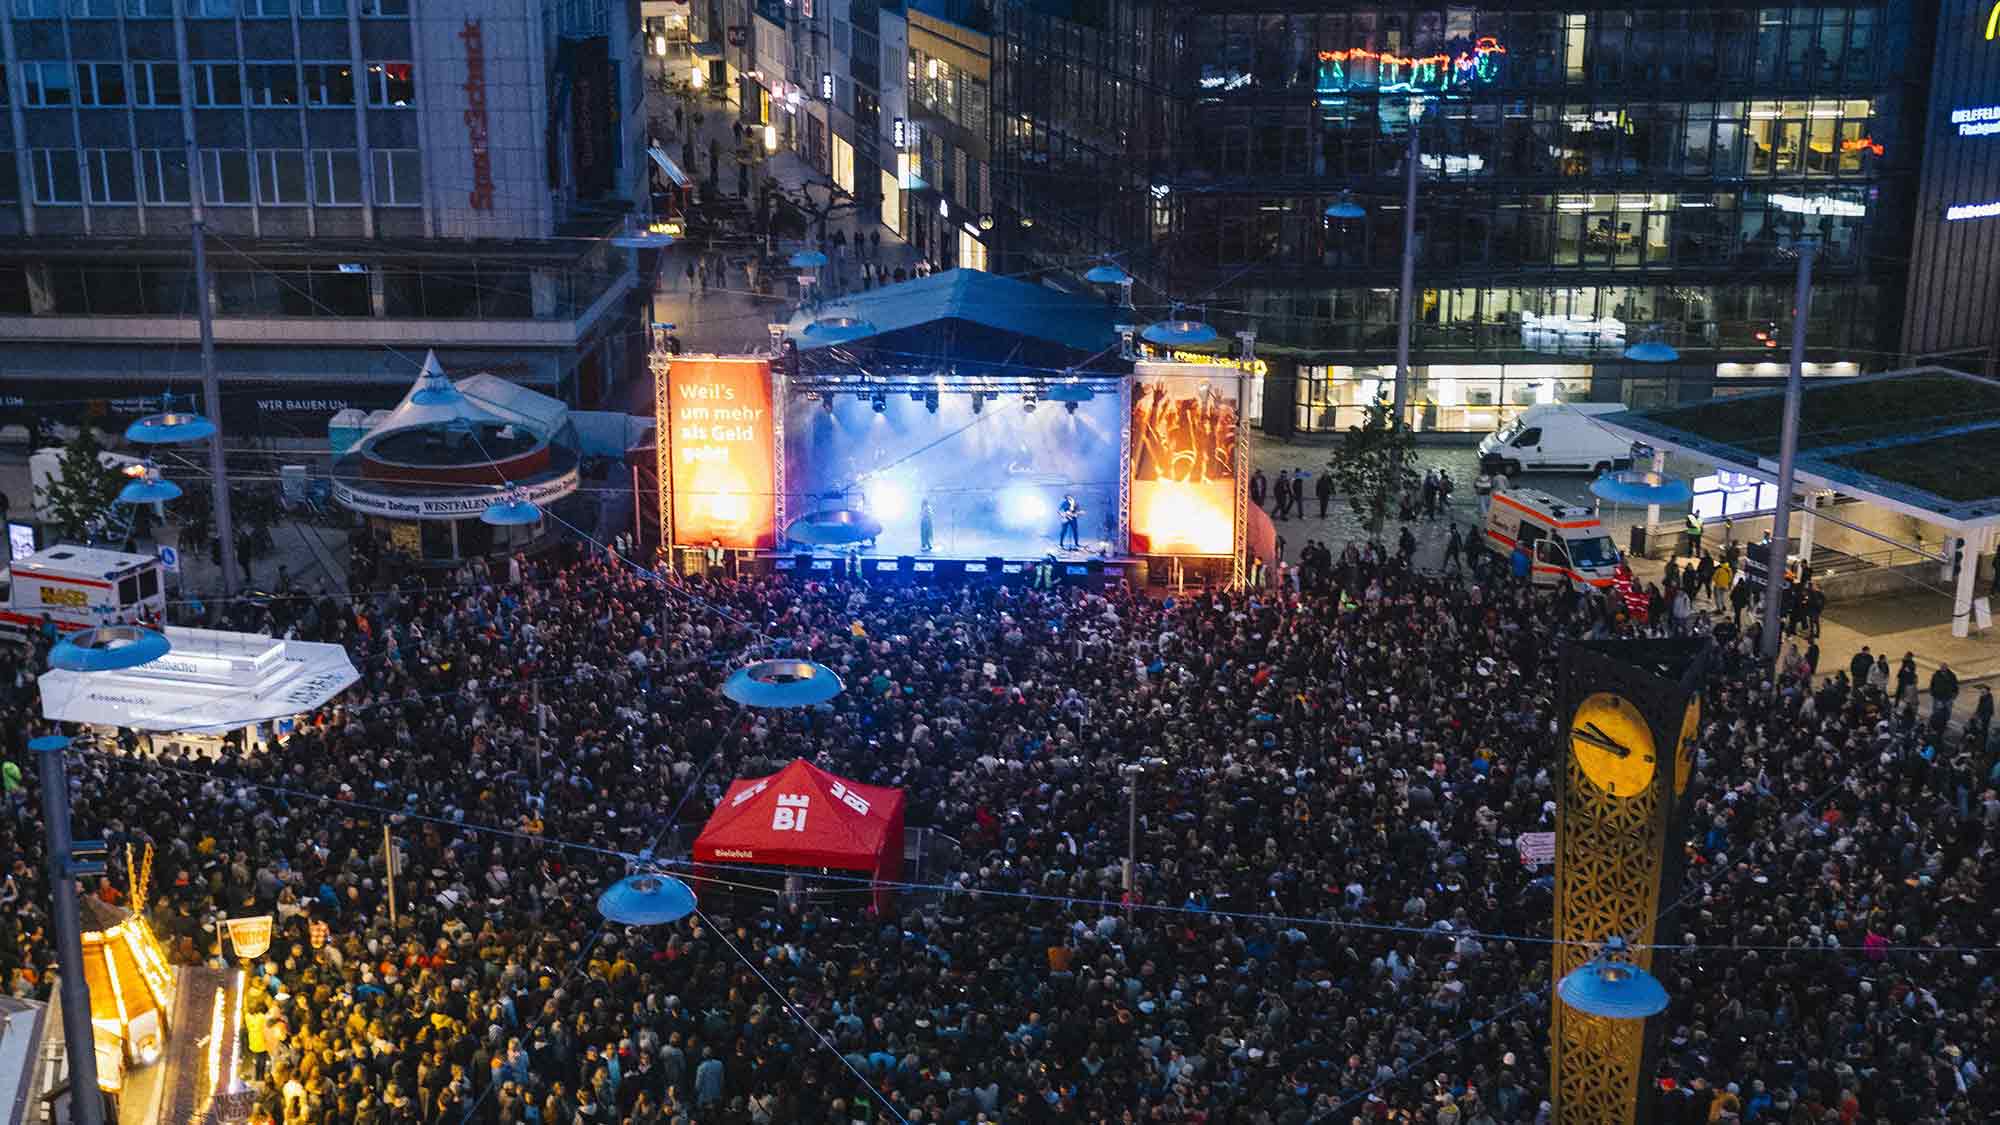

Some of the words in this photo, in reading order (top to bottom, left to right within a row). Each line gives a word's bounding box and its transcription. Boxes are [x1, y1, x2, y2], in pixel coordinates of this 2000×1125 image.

[680, 383, 737, 401] Weil's
[285, 400, 327, 411] BAUEN
[681, 407, 709, 419] um
[714, 404, 765, 420] mehr
[680, 425, 707, 440] als
[711, 425, 753, 441] Geld
